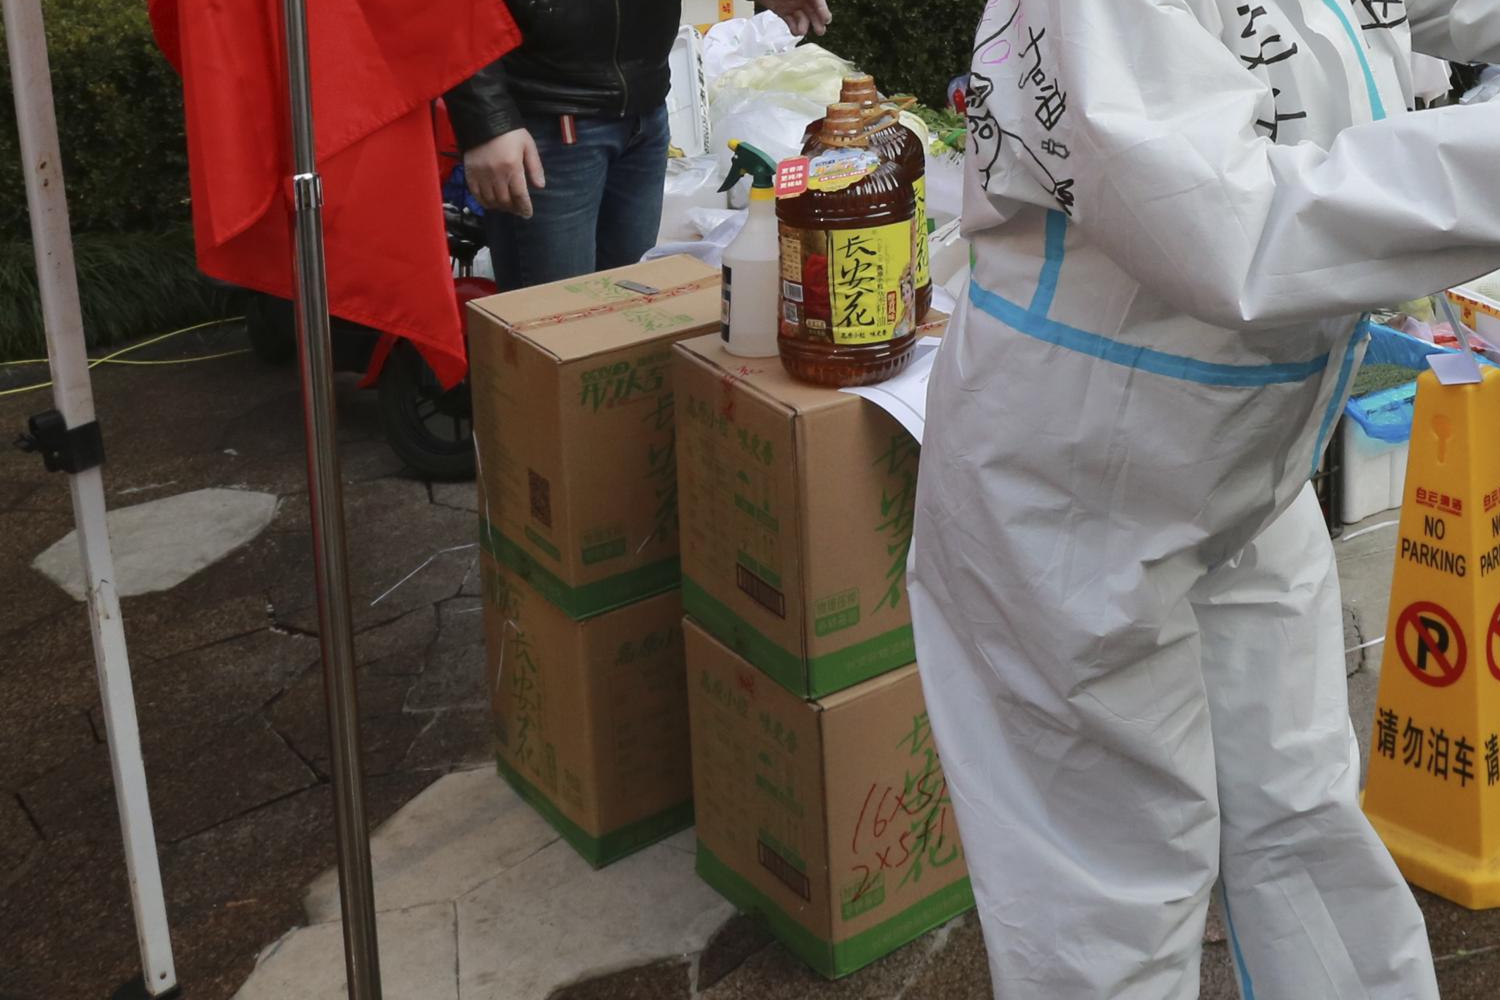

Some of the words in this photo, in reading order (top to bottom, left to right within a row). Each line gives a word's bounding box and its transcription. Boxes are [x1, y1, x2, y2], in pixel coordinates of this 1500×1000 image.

[837, 235, 878, 328] 长安花
[1424, 515, 1446, 540] NO
[1401, 538, 1466, 577] PARKING
[1417, 615, 1449, 670] P
[1377, 707, 1475, 788] 请勿泊车
